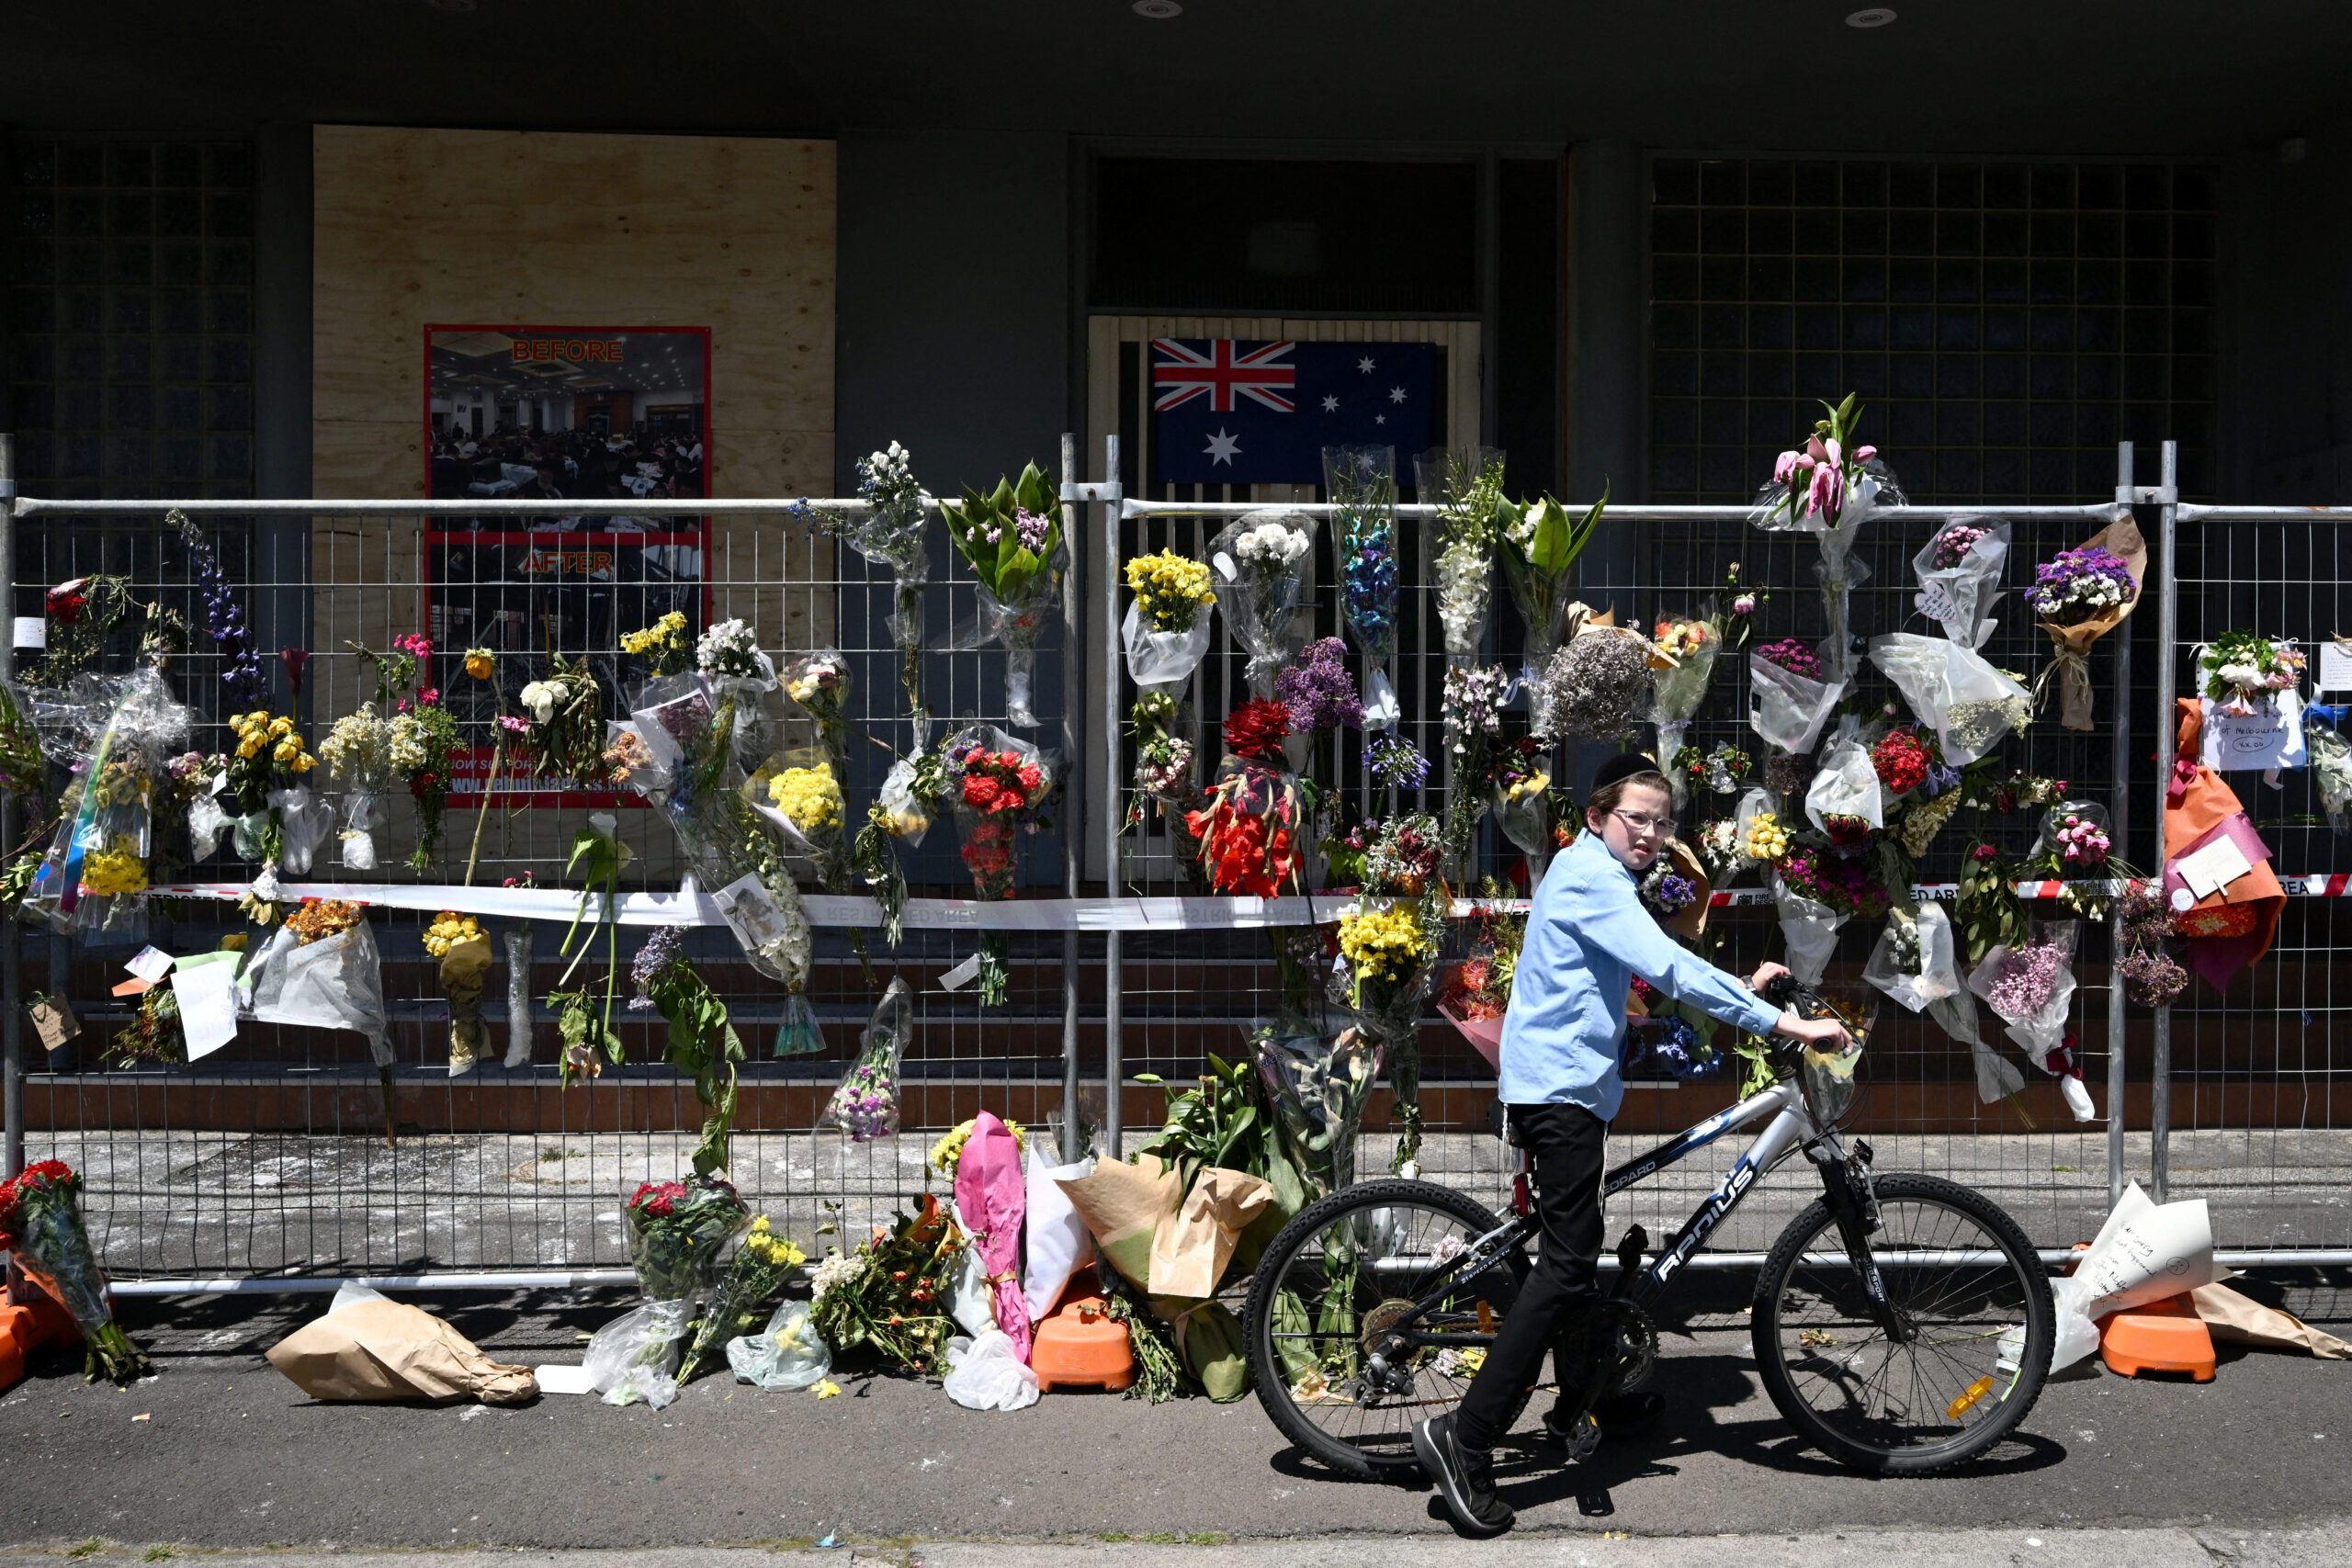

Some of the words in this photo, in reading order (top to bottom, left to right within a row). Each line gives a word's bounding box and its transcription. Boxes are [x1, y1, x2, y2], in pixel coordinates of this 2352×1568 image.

[512, 339, 625, 362] BEFORE
[523, 551, 613, 574] AFTER
[2222, 727, 2232, 736] of
[2280, 881, 2310, 896] REA
[1602, 1161, 1657, 1195] EOPARD
[1657, 1165, 1754, 1282] RADIUS
[1461, 1275, 1469, 1284] 21
[1469, 1264, 1488, 1279] SPEED
[1488, 1248, 1510, 1264] SYSEM
